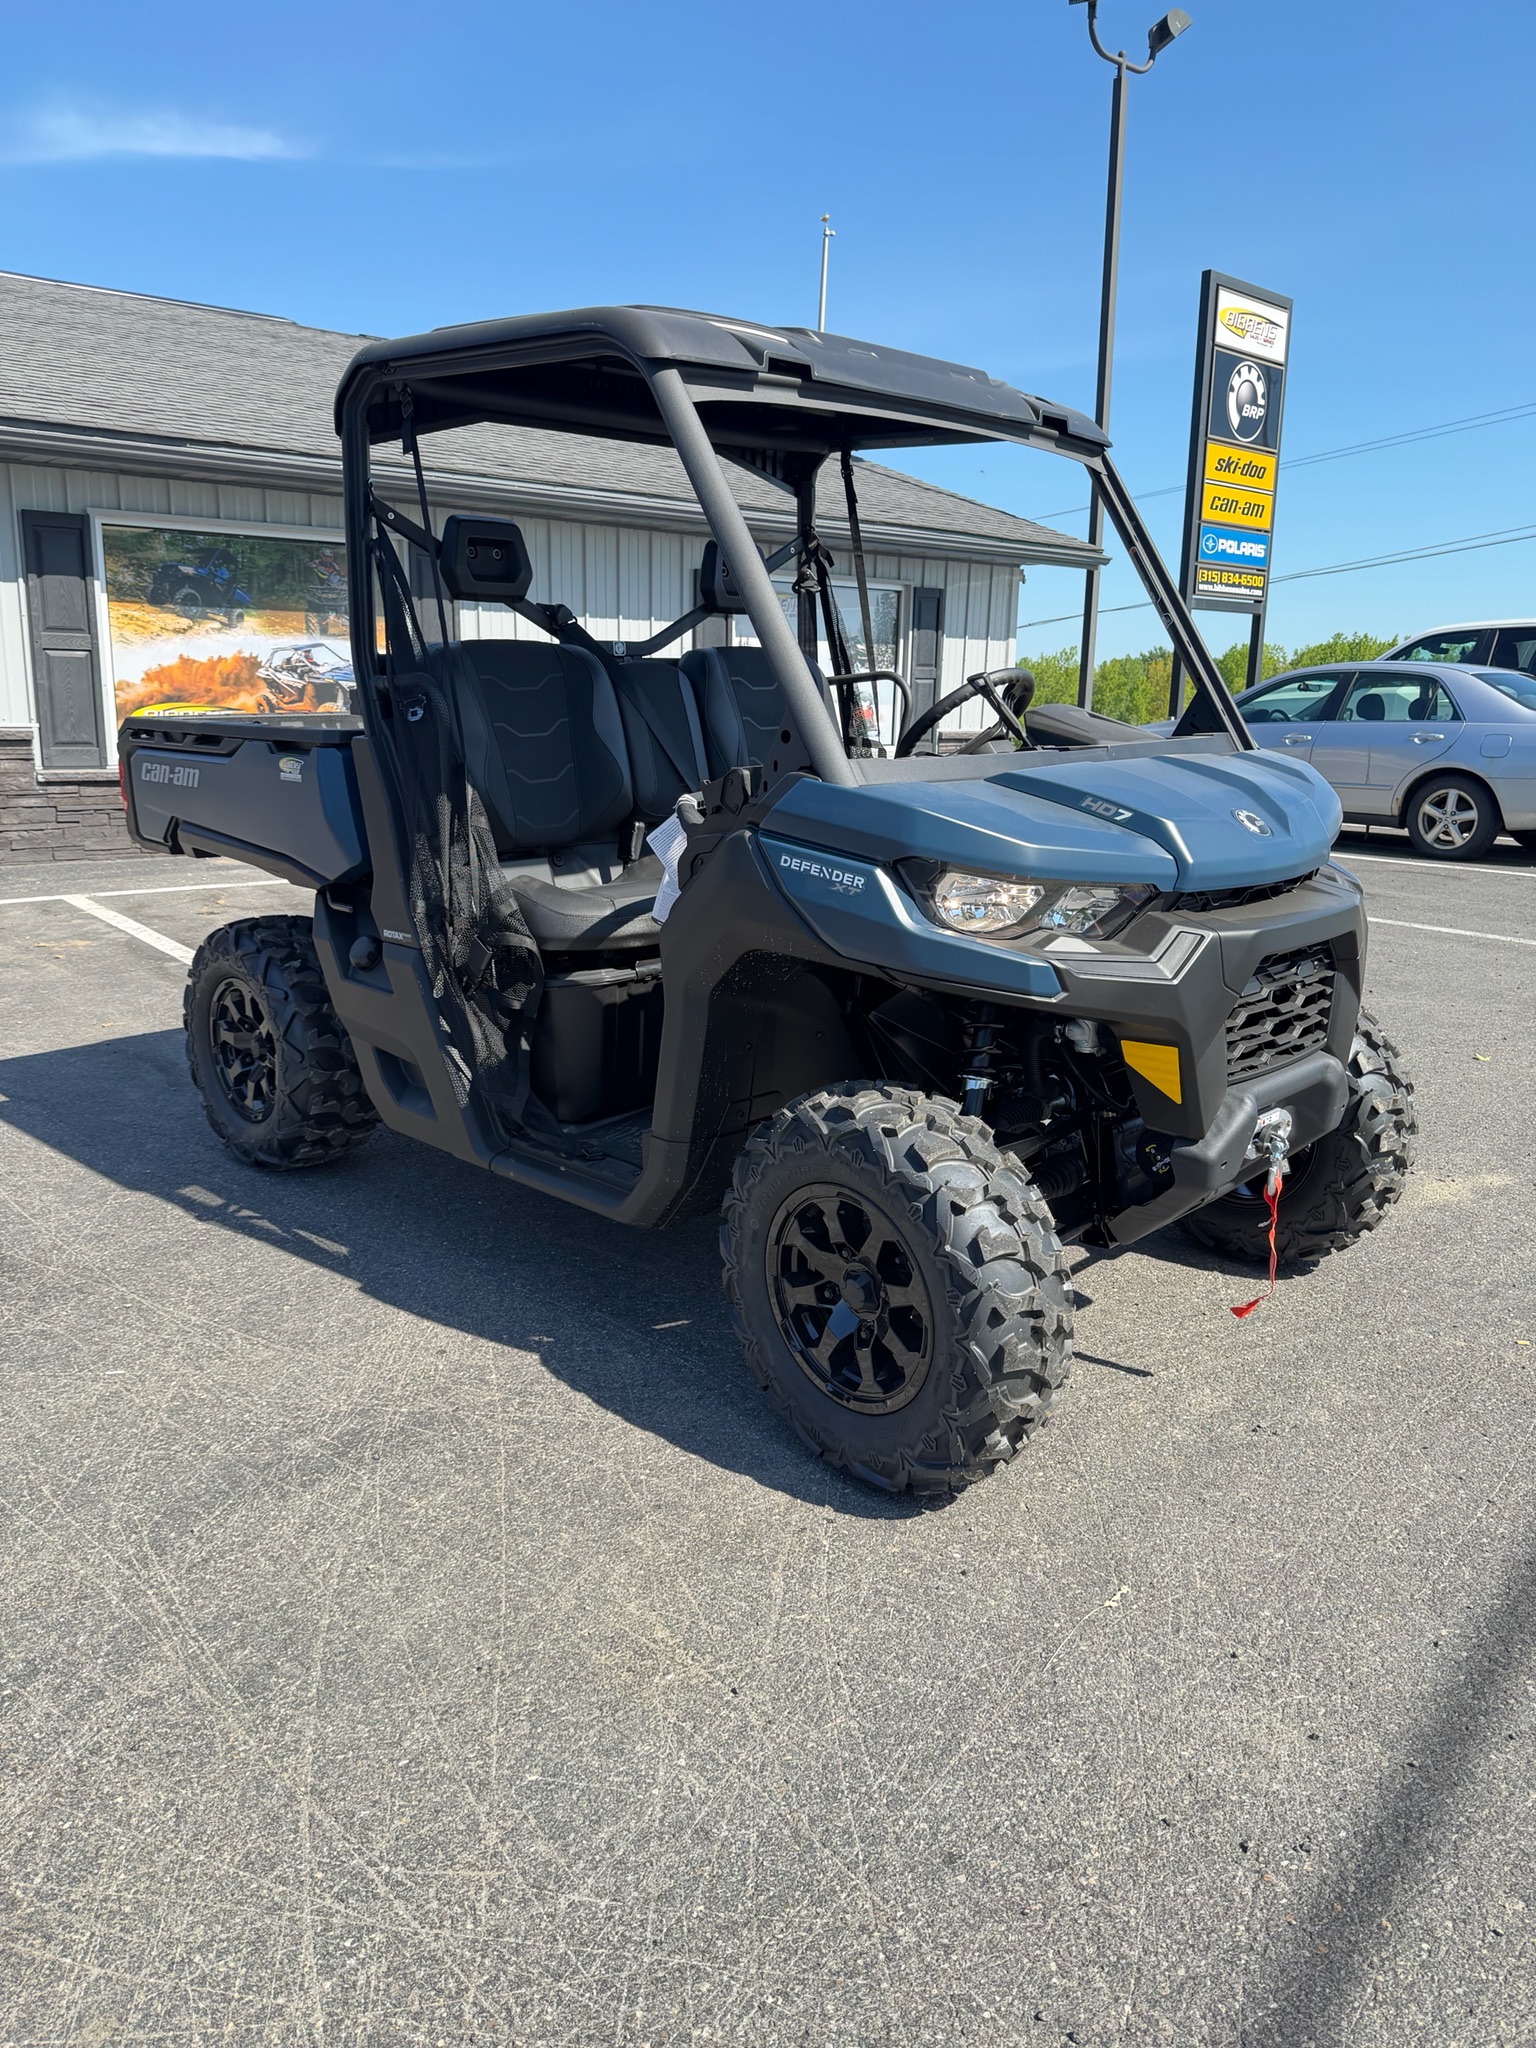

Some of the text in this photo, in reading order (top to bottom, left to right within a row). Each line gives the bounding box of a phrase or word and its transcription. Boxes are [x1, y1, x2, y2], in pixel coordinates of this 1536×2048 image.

[1225, 310, 1278, 341] BIBBENS
[1241, 403, 1265, 420] BRP
[1214, 456, 1267, 480] ski-doo
[1209, 495, 1265, 519] can-am
[1218, 538, 1266, 558] POLARIS
[1198, 569, 1264, 587] (315) 834-6500
[141, 762, 200, 788] can-am
[1080, 796, 1133, 821] HD7
[780, 855, 865, 889] DEFENDER
[831, 882, 861, 896] XT
[383, 929, 404, 940] ROTAX
